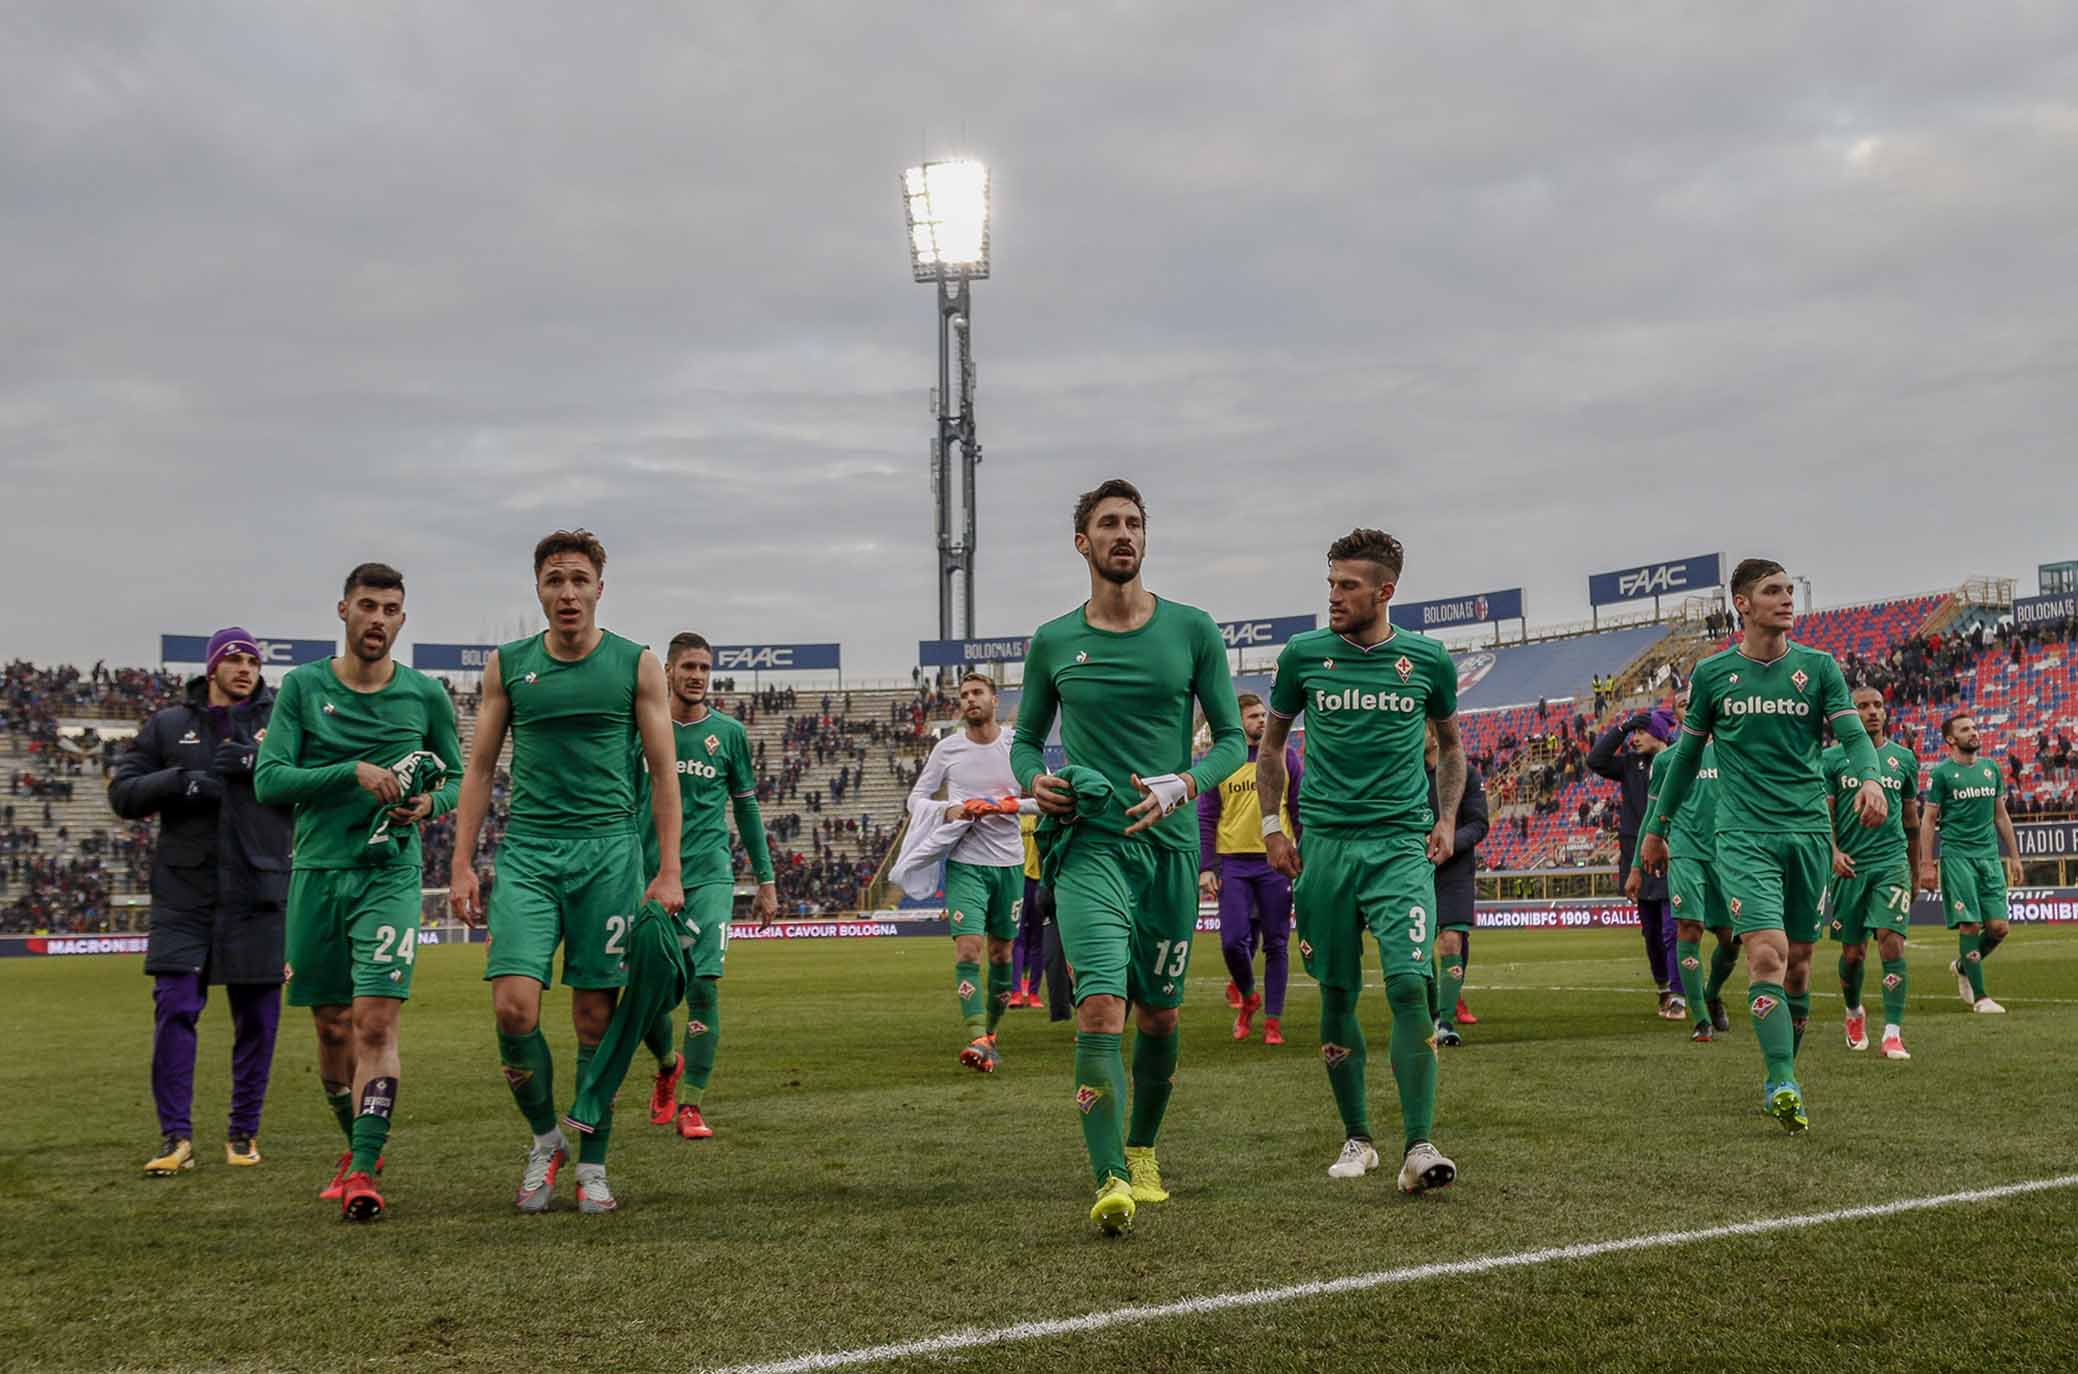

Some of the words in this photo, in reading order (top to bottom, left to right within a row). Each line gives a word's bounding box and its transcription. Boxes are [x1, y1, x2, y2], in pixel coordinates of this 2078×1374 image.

[1619, 565, 1687, 596] FAAC
[1424, 602, 1465, 624] BOLOGNA
[1219, 623, 1272, 646] AAC
[718, 647, 793, 668] FAAC
[1315, 688, 1415, 713] folletto
[1723, 696, 1809, 716] folletto
[1840, 775, 1901, 790] fotto
[1952, 786, 1995, 800] folletto
[2016, 828, 2065, 853] TADIO
[1408, 905, 1426, 943] 3
[1560, 911, 1591, 925] 1909
[786, 925, 837, 938] CAVOUR
[839, 924, 898, 937] BOLOGNA
[373, 925, 415, 965] 24
[1154, 940, 1188, 977] 13
